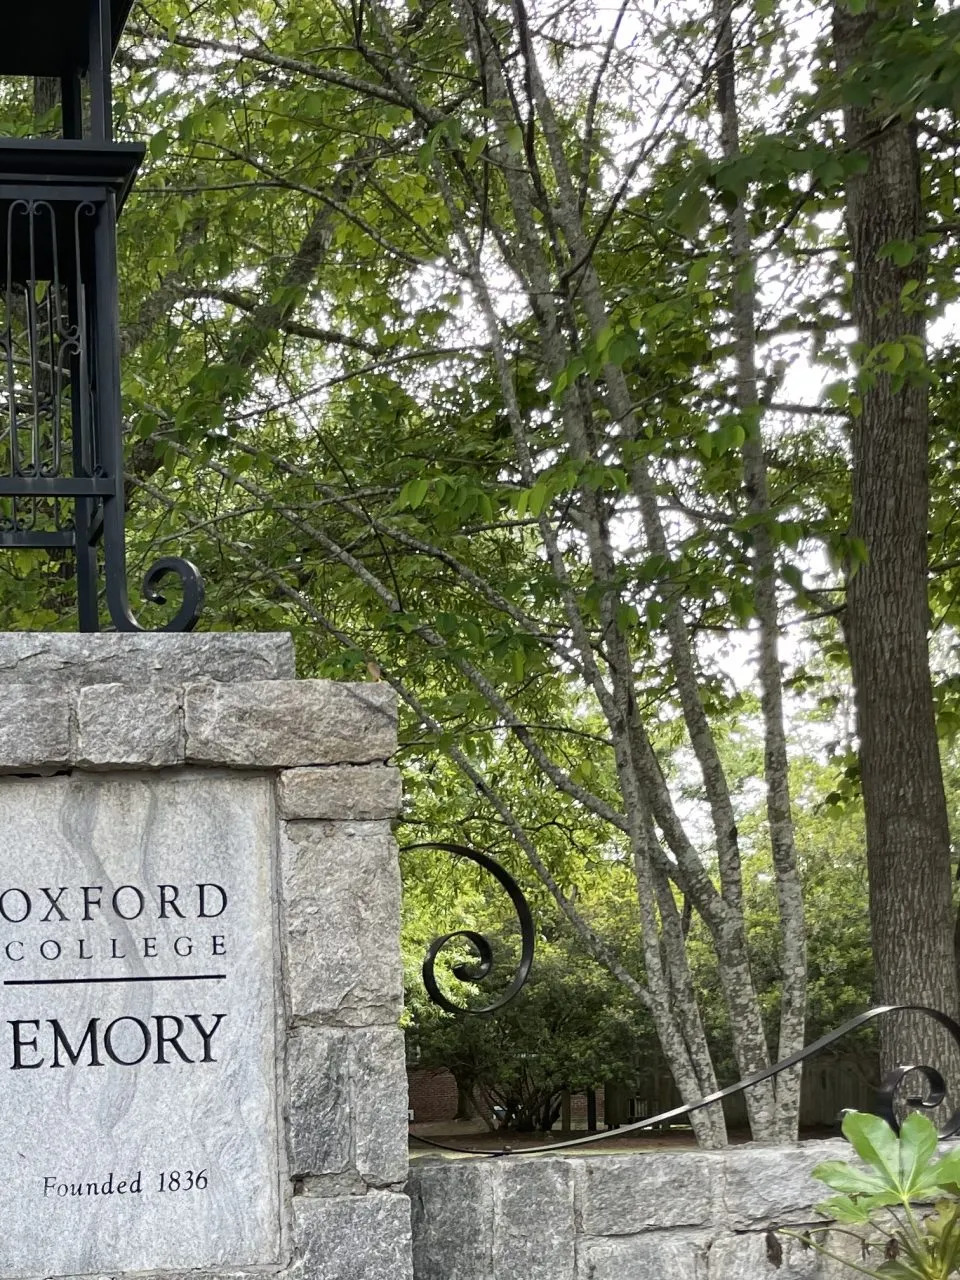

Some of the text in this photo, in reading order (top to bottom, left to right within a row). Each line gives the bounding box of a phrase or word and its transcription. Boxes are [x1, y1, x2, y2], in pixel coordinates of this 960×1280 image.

[5, 935, 227, 961] COLLEGE
[6, 1013, 227, 1070] EMORY
[43, 1168, 209, 1197] Founded 1836
